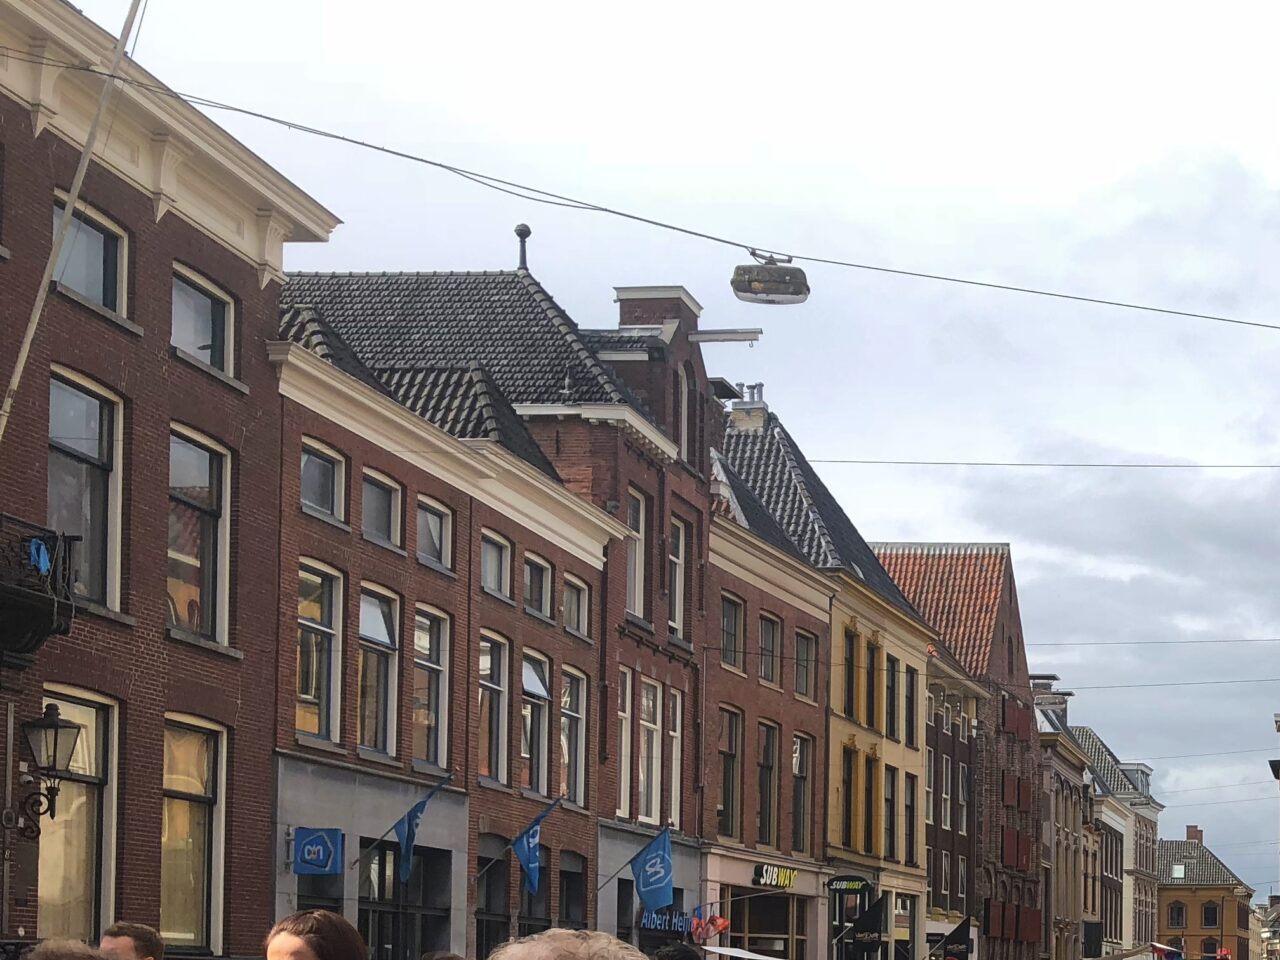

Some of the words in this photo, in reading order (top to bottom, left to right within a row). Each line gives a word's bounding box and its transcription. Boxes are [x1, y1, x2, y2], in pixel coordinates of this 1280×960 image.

[760, 864, 798, 888] SUBWAY
[830, 880, 866, 889] SUBWAY
[640, 911, 669, 930] Albert
